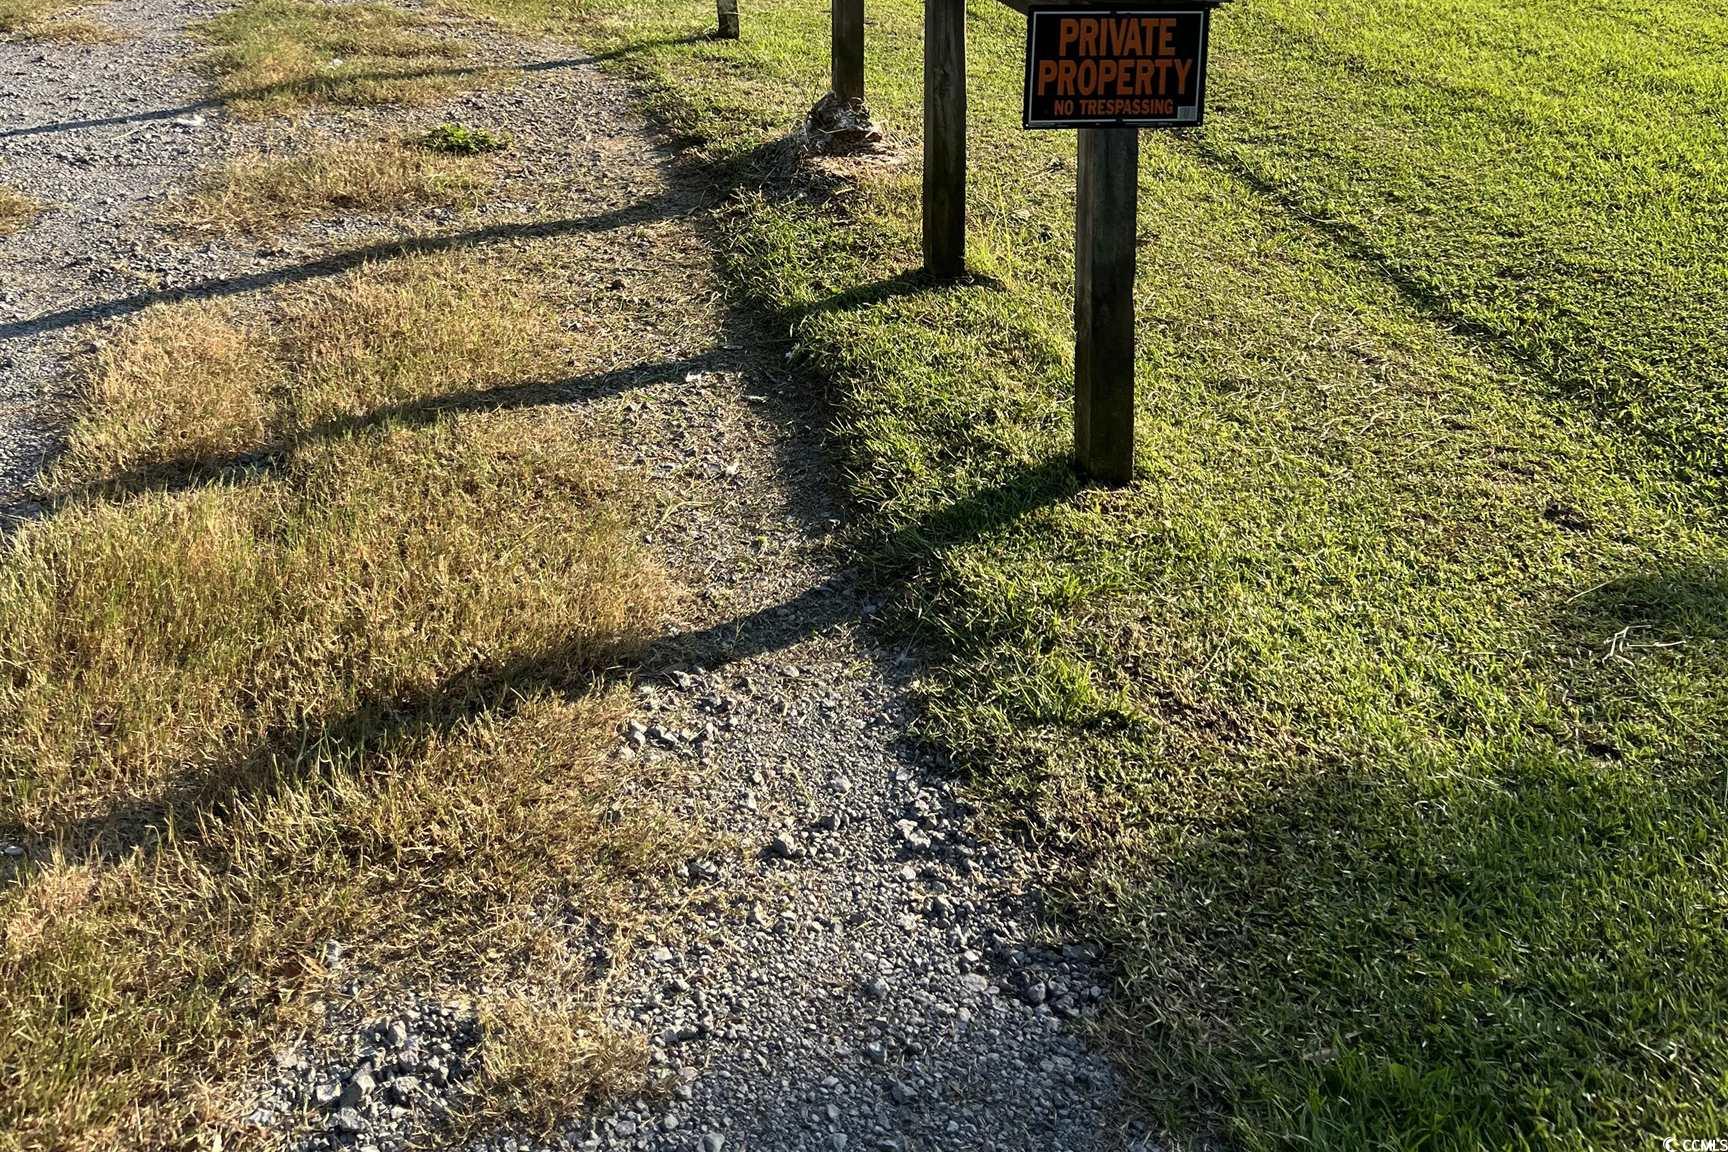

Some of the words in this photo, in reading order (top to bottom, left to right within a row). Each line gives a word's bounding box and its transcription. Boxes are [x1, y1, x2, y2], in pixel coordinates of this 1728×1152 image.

[1058, 17, 1177, 57] PRIVATE
[1036, 58, 1193, 97] PROPERTY
[1053, 99, 1074, 116] NO
[1079, 98, 1174, 116] TRESPASSING
